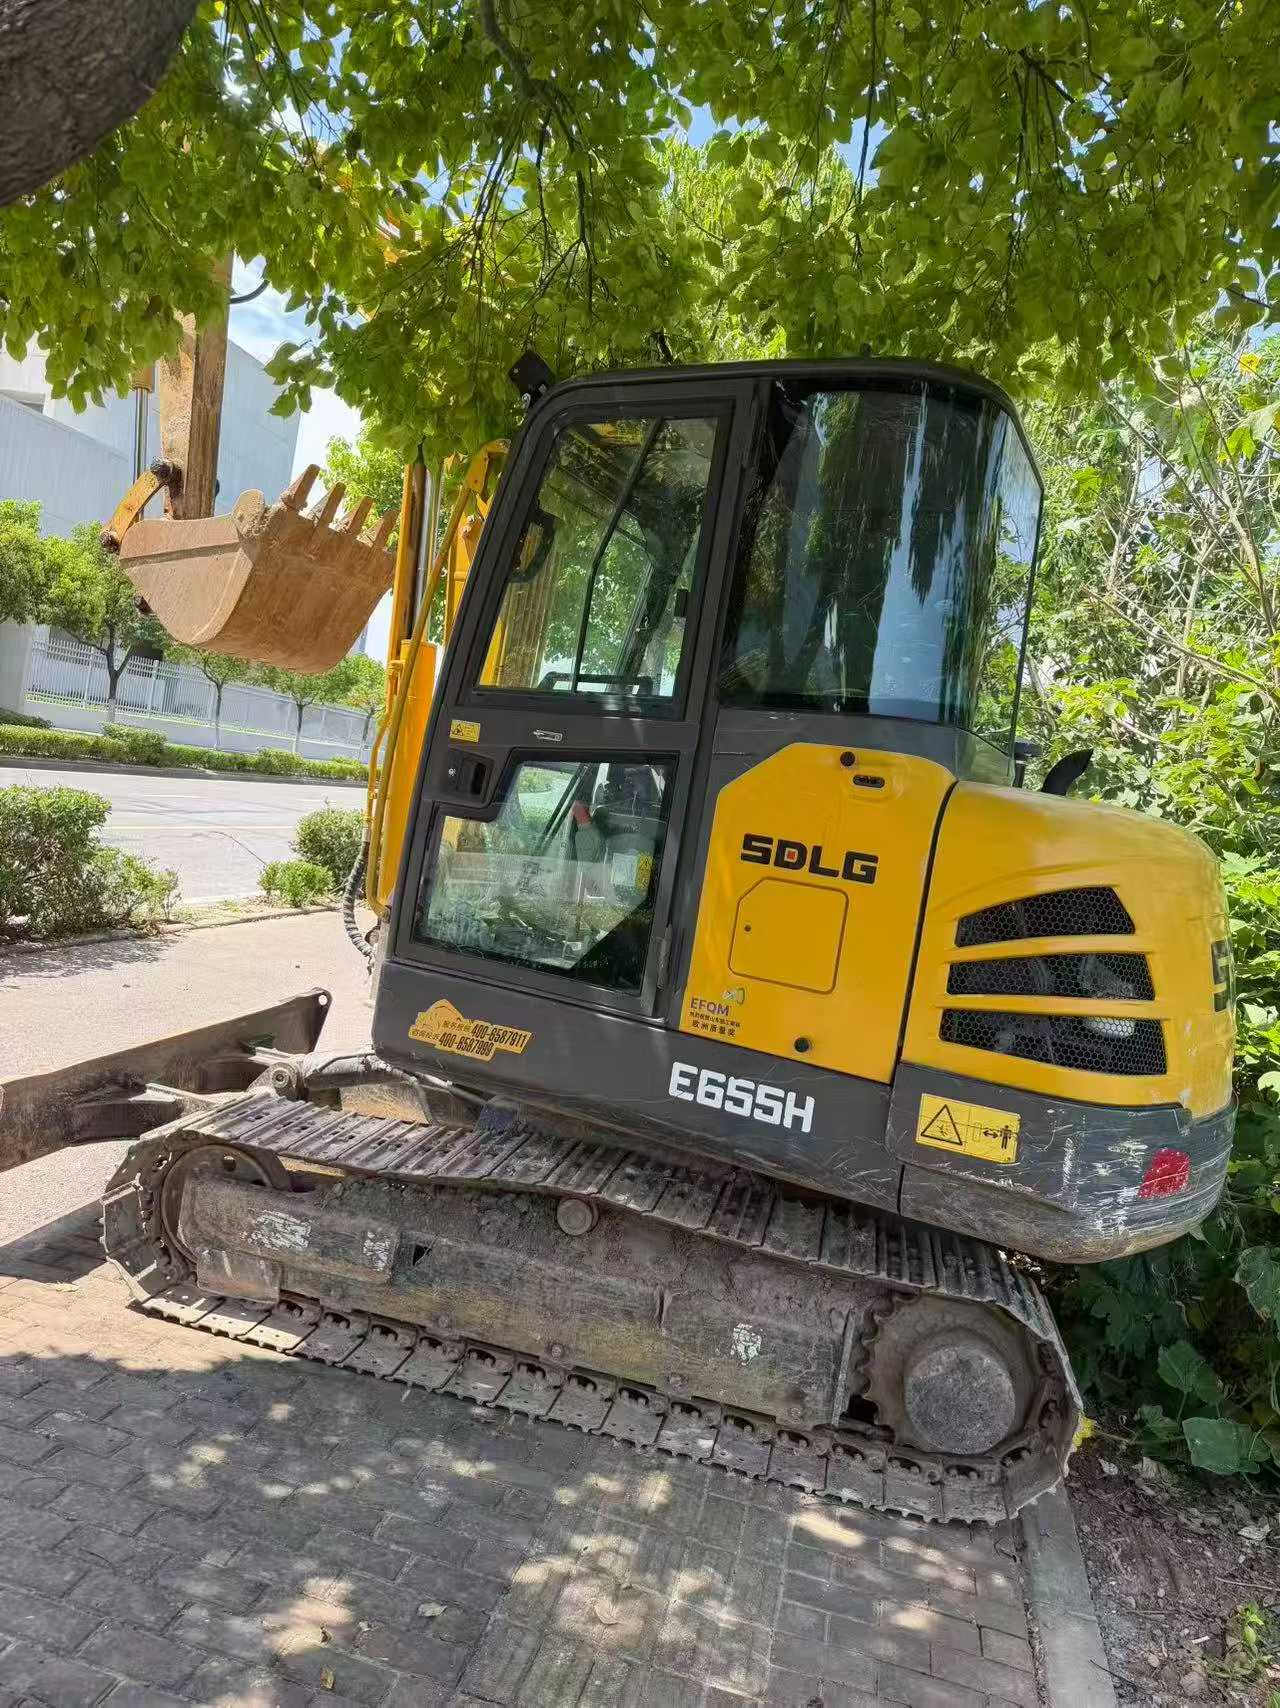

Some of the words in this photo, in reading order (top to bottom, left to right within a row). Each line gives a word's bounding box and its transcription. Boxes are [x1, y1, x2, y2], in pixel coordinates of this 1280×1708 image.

[741, 833, 879, 884] SDLG
[690, 997, 730, 1016] EFQM
[668, 1061, 815, 1133] E655H
